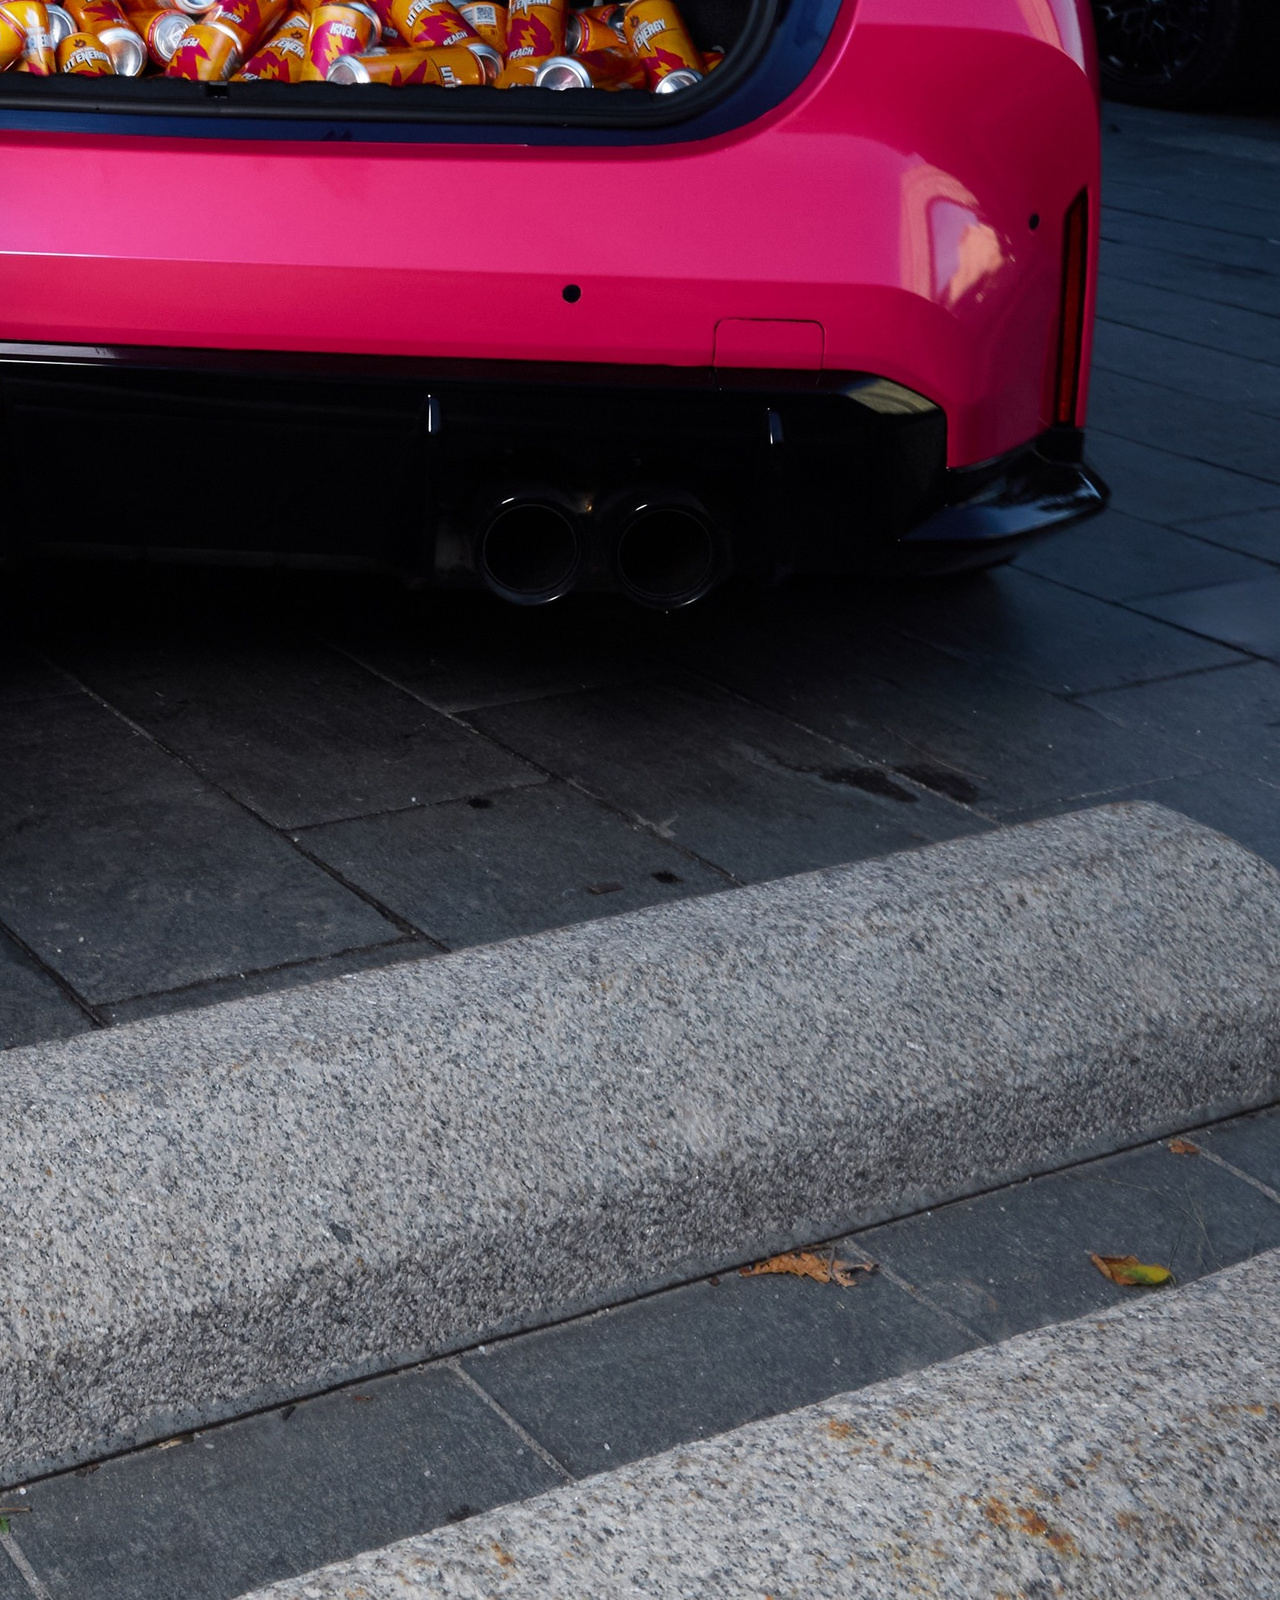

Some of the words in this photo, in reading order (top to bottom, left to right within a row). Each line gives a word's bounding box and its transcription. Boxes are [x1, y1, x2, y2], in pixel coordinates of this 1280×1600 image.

[406, 8, 417, 28] LIT
[330, 22, 357, 39] PEACH
[383, 27, 398, 38] ACH
[276, 39, 305, 59] ENER
[508, 47, 534, 60] PEACH
[63, 56, 76, 73] LIT
